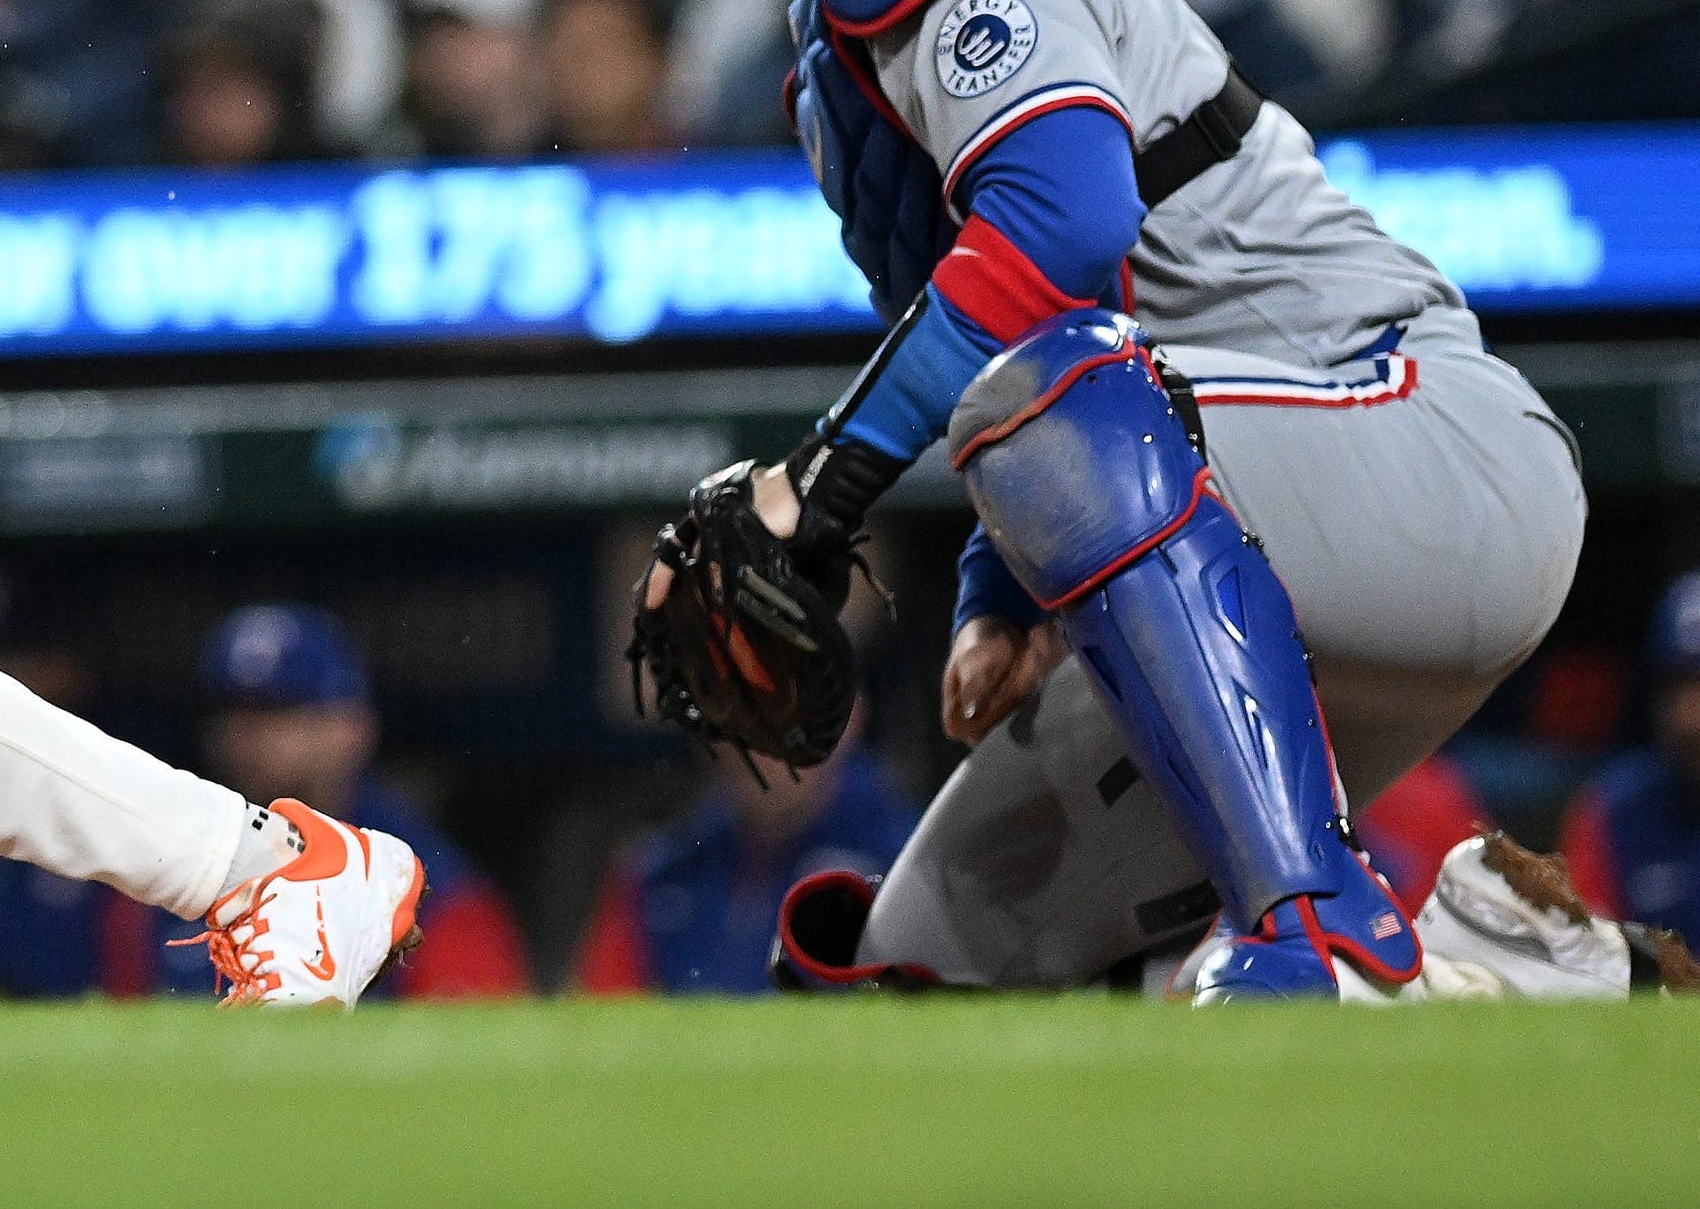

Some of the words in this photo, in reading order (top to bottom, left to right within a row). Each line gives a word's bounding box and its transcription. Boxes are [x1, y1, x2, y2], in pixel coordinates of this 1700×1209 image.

[948, 23, 1032, 92] TRANSFER
[84, 203, 349, 332] over
[352, 167, 588, 322] 175
